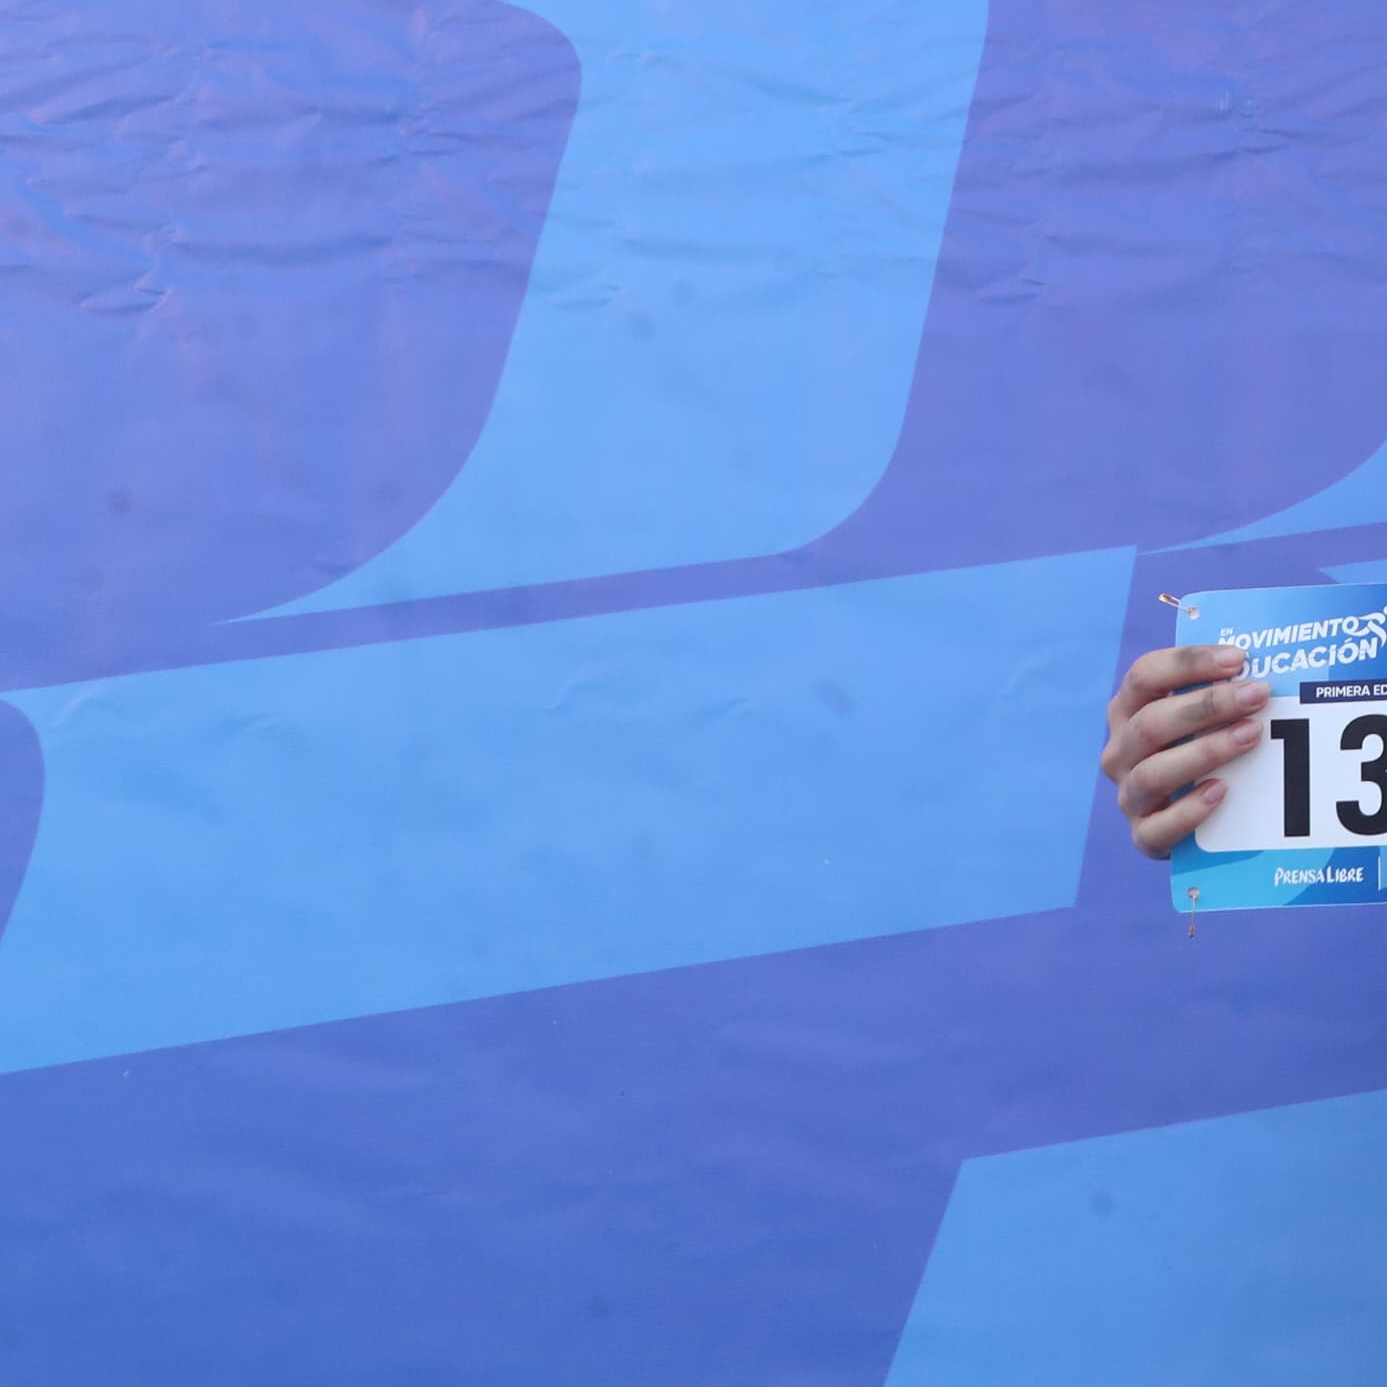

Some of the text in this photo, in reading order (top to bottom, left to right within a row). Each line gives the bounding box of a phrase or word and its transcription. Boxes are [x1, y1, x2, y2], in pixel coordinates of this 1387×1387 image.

[1315, 683, 1371, 699] PRIMERA
[1273, 865, 1365, 887] PRENSA LIBRE
